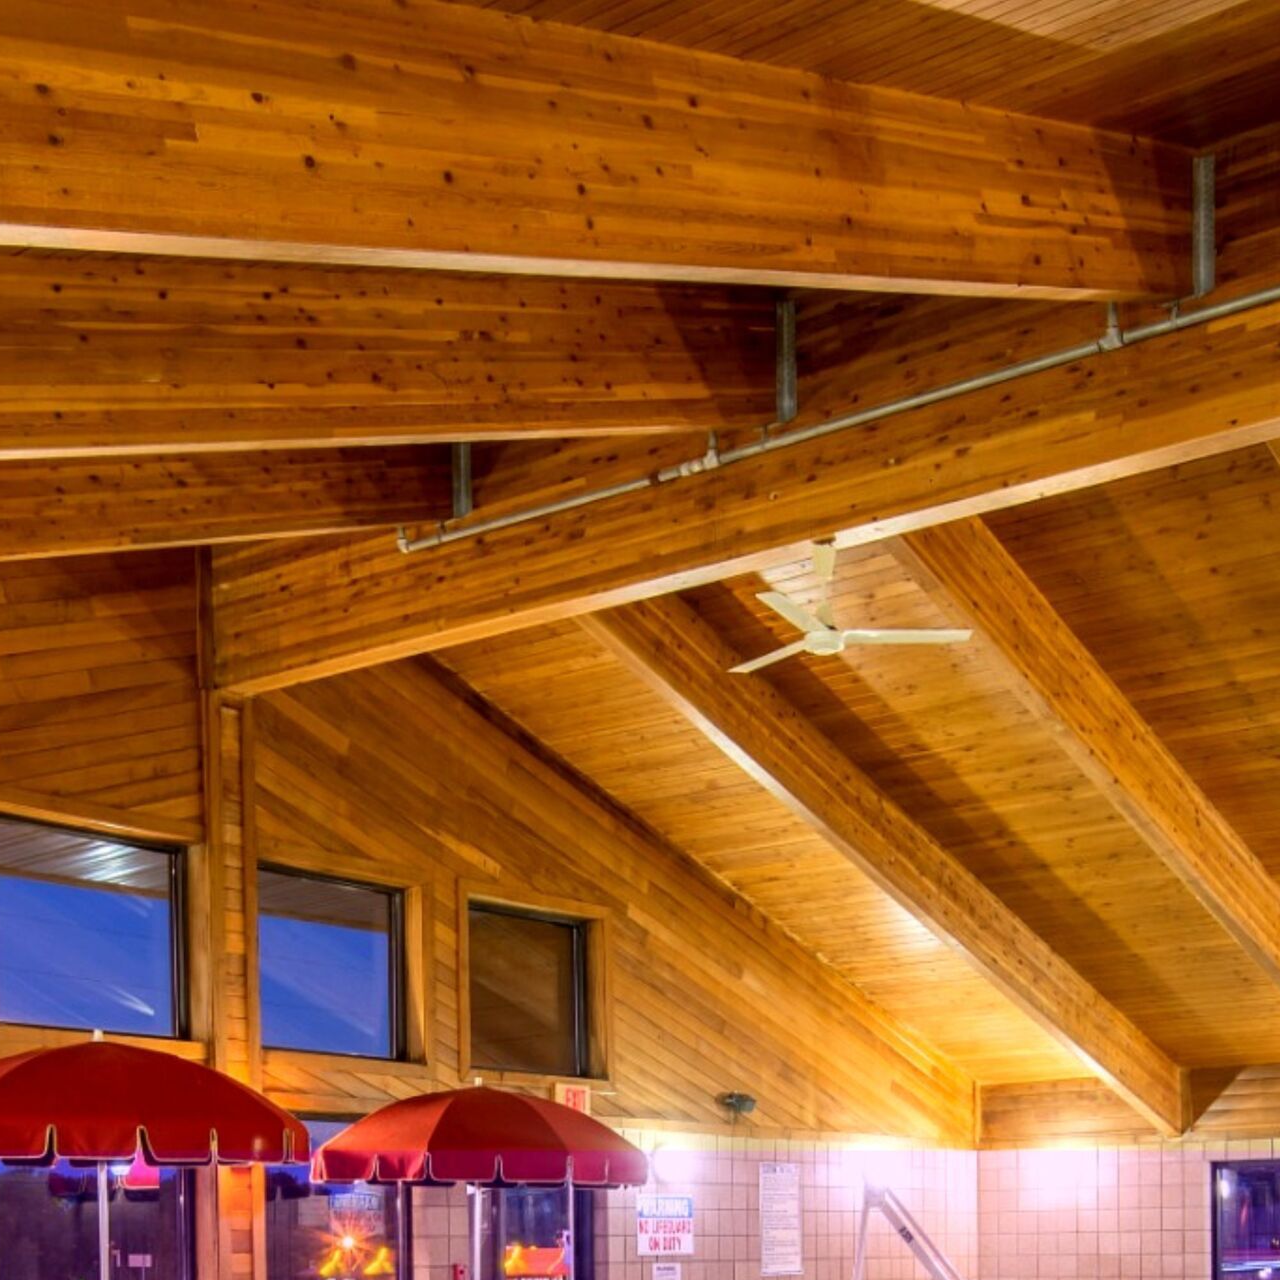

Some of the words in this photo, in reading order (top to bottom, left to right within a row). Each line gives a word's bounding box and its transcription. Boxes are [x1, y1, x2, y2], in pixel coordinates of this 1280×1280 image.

[565, 1087, 586, 1112] EXIT
[639, 1219, 649, 1234] NO
[652, 1219, 692, 1234] LIFEGUARD
[648, 1236, 661, 1251] ON
[663, 1236, 681, 1251] DUTY
